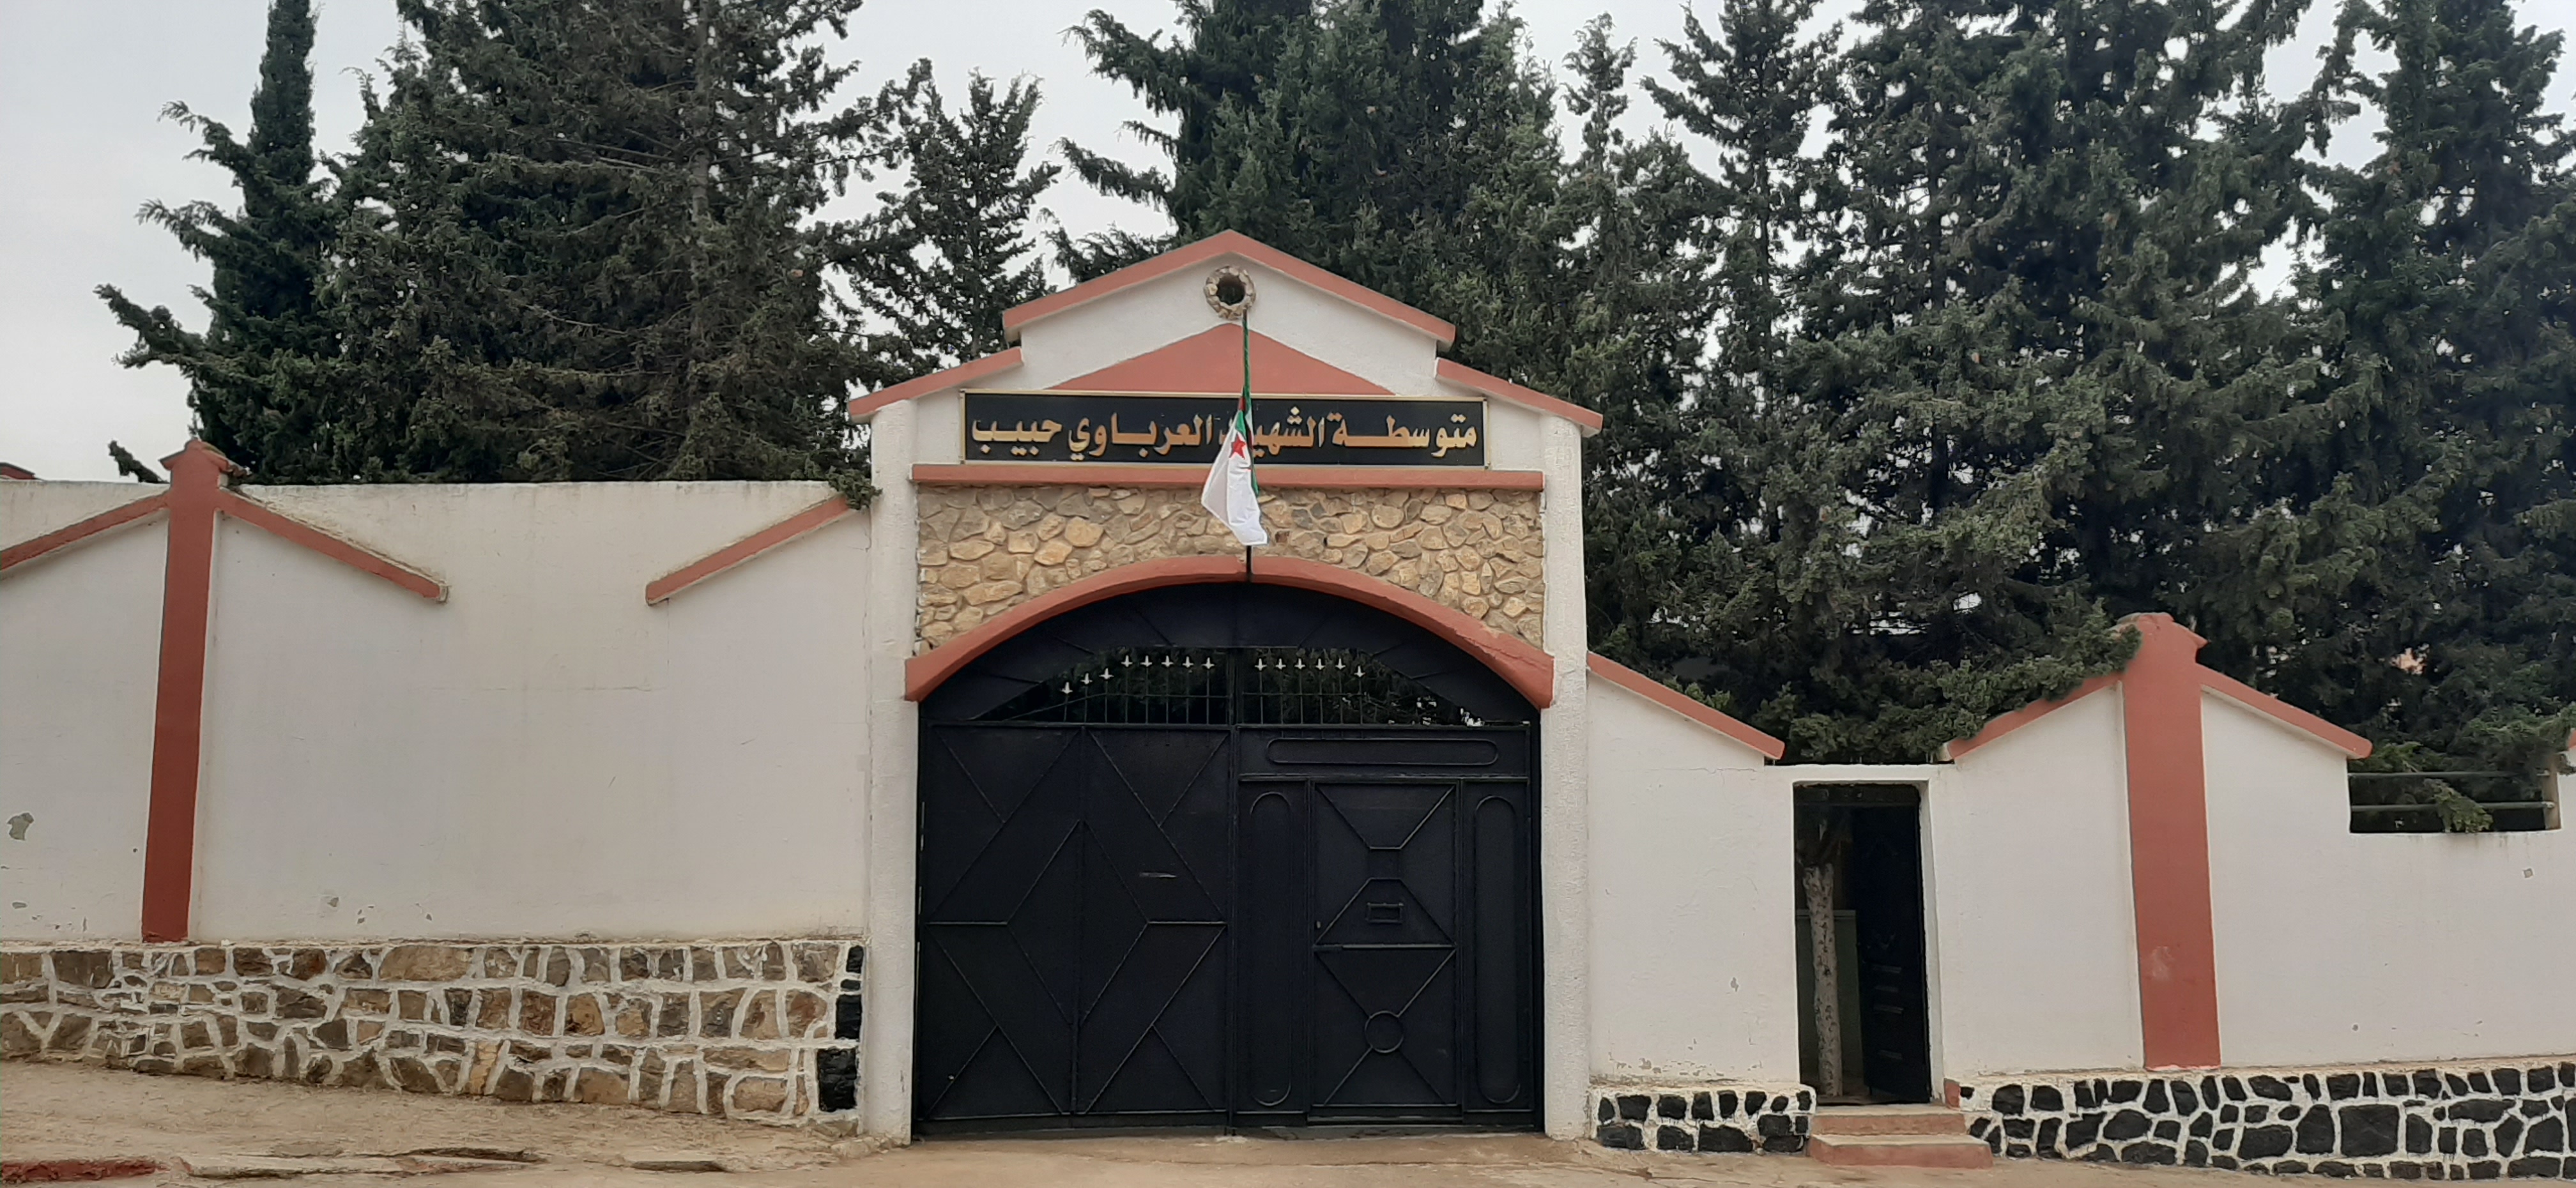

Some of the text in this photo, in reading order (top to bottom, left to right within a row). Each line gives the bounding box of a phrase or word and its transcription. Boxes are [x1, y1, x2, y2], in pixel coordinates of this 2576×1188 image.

[972, 419, 1062, 456] حبيب
[1068, 413, 1213, 461] العرباوي
[1327, 411, 1477, 457] متوسطة
